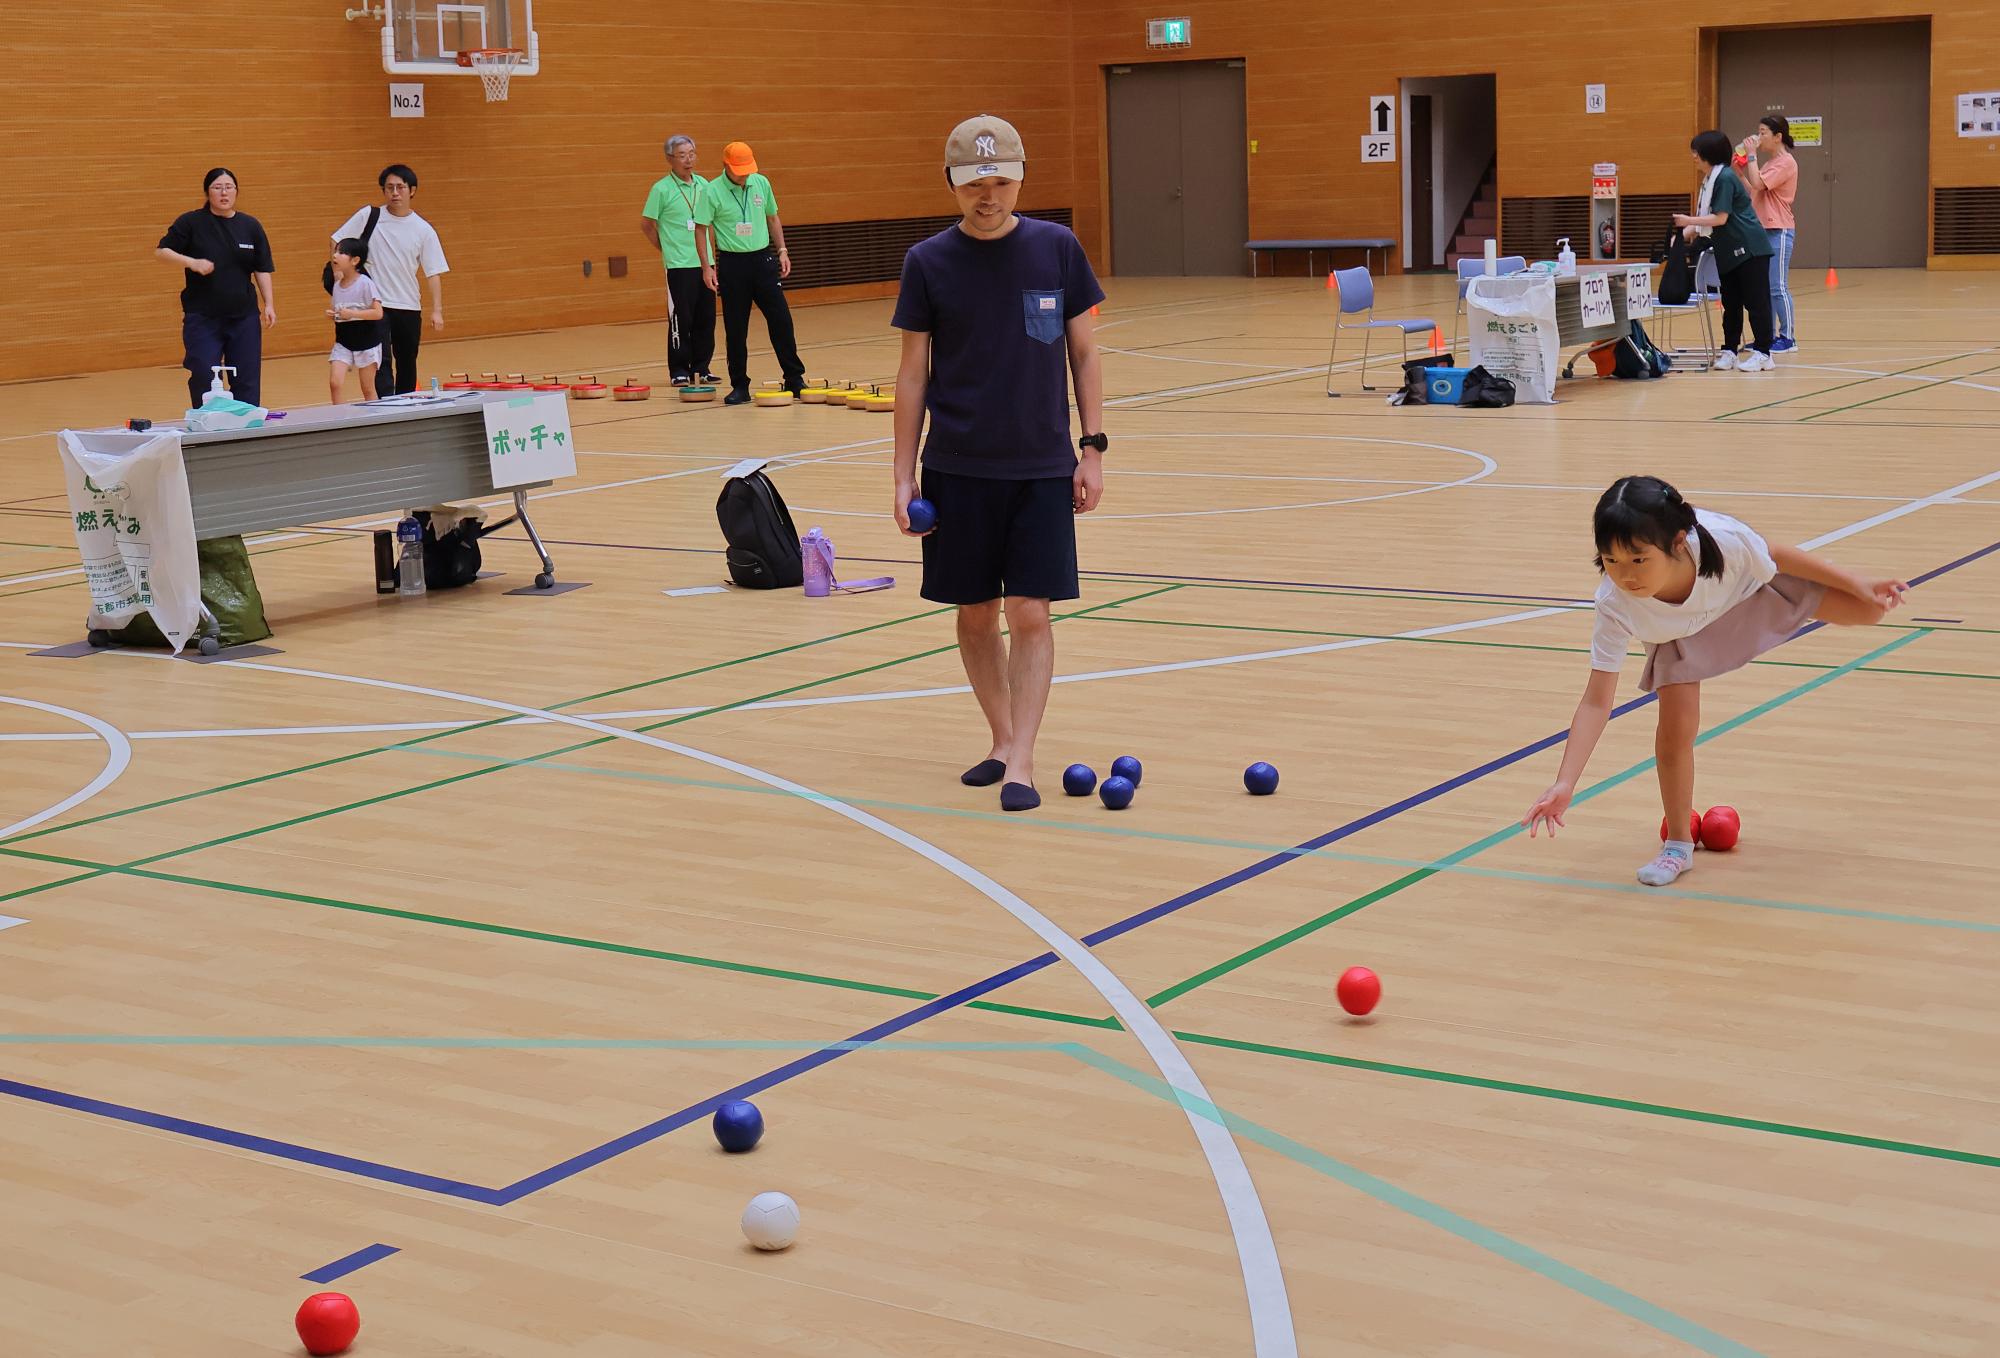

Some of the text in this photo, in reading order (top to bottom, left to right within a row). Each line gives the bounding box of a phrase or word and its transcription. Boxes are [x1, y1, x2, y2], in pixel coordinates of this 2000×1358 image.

[394, 94, 421, 108] No.2
[975, 135, 996, 158] NY
[1368, 142, 1390, 157] 2F
[1585, 278, 1604, 295] フロア
[1630, 272, 1647, 288] フロア
[1487, 321, 1538, 334] 燃えるごみ
[492, 424, 565, 455] ボッチャ
